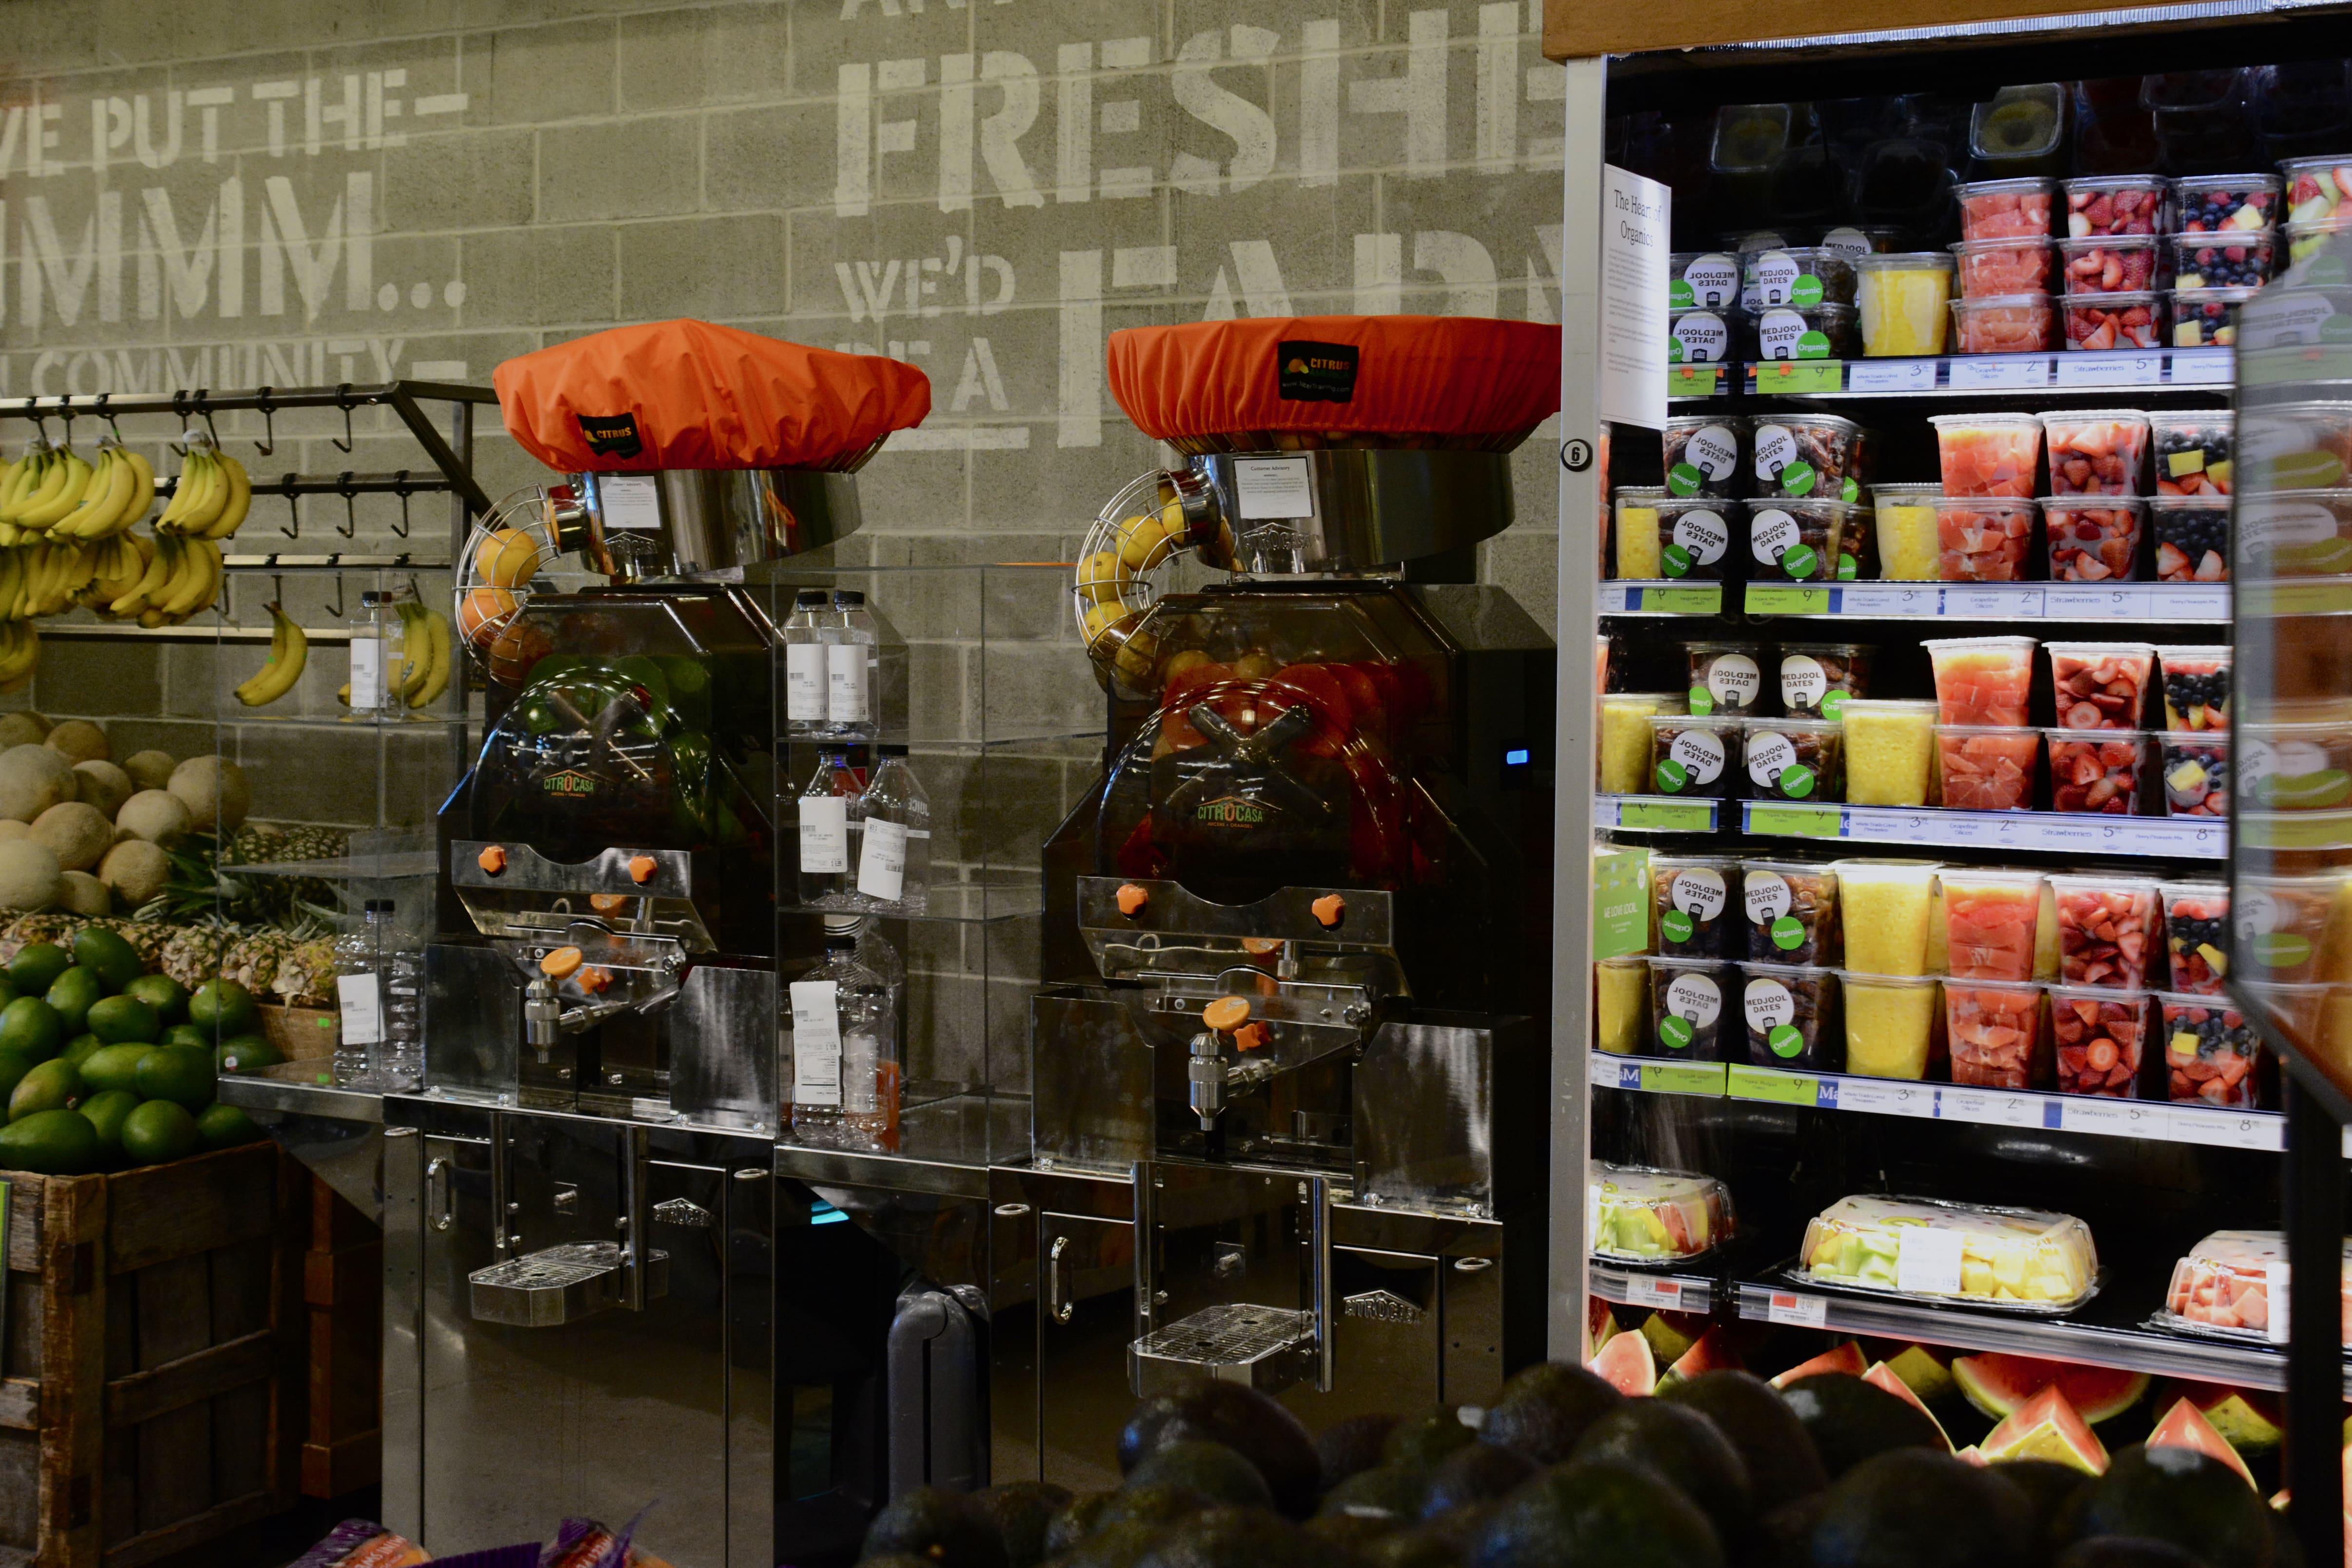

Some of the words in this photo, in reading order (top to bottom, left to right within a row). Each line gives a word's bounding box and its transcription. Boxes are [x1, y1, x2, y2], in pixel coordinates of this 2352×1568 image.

[93, 87, 234, 172] PUT
[252, 69, 406, 156] THE
[1614, 189, 1629, 211] The
[1631, 196, 1651, 218] Heart
[1653, 204, 1662, 223] of
[1620, 220, 1654, 248] Organics
[835, 235, 1016, 322] WE'D
[1764, 276, 1787, 284] DATES
[1792, 286, 1821, 296] Organic
[1761, 324, 1802, 335] MEDJOOL
[1767, 333, 1795, 342] DATES
[1798, 342, 1828, 352] Organic
[31, 338, 404, 396] COMMUNITY
[1310, 358, 1350, 370] CITRUS
[950, 337, 1009, 411] A
[596, 427, 632, 439] CITRUS
[1571, 446, 1580, 464] 6
[1759, 446, 1784, 463] DATES
[1784, 469, 1812, 488] Organic
[1753, 519, 1791, 544] MEDJOOL
[1760, 529, 1786, 548] DATES
[1786, 551, 1813, 570] Organic
[1781, 671, 1821, 680] MEDJOOL
[1786, 679, 1813, 687] DATES
[1749, 742, 1787, 765] MEDJOOL
[1756, 753, 1783, 770] DATES
[544, 775, 593, 792] CITROCASA
[1783, 772, 1810, 791] Organic
[1197, 802, 1263, 823] CITROCASA
[2042, 829, 2092, 837] Strawberries
[1751, 892, 1778, 905] DATES
[1604, 907, 1610, 918] WE
[1611, 905, 1622, 917] LOVE
[1773, 928, 1802, 939] Organic
[1746, 994, 1787, 1007] MEDJOOL
[1753, 1003, 1781, 1013] DATES
[1773, 1031, 1798, 1051] Organic
[2067, 1108, 2118, 1119] Strawberries
